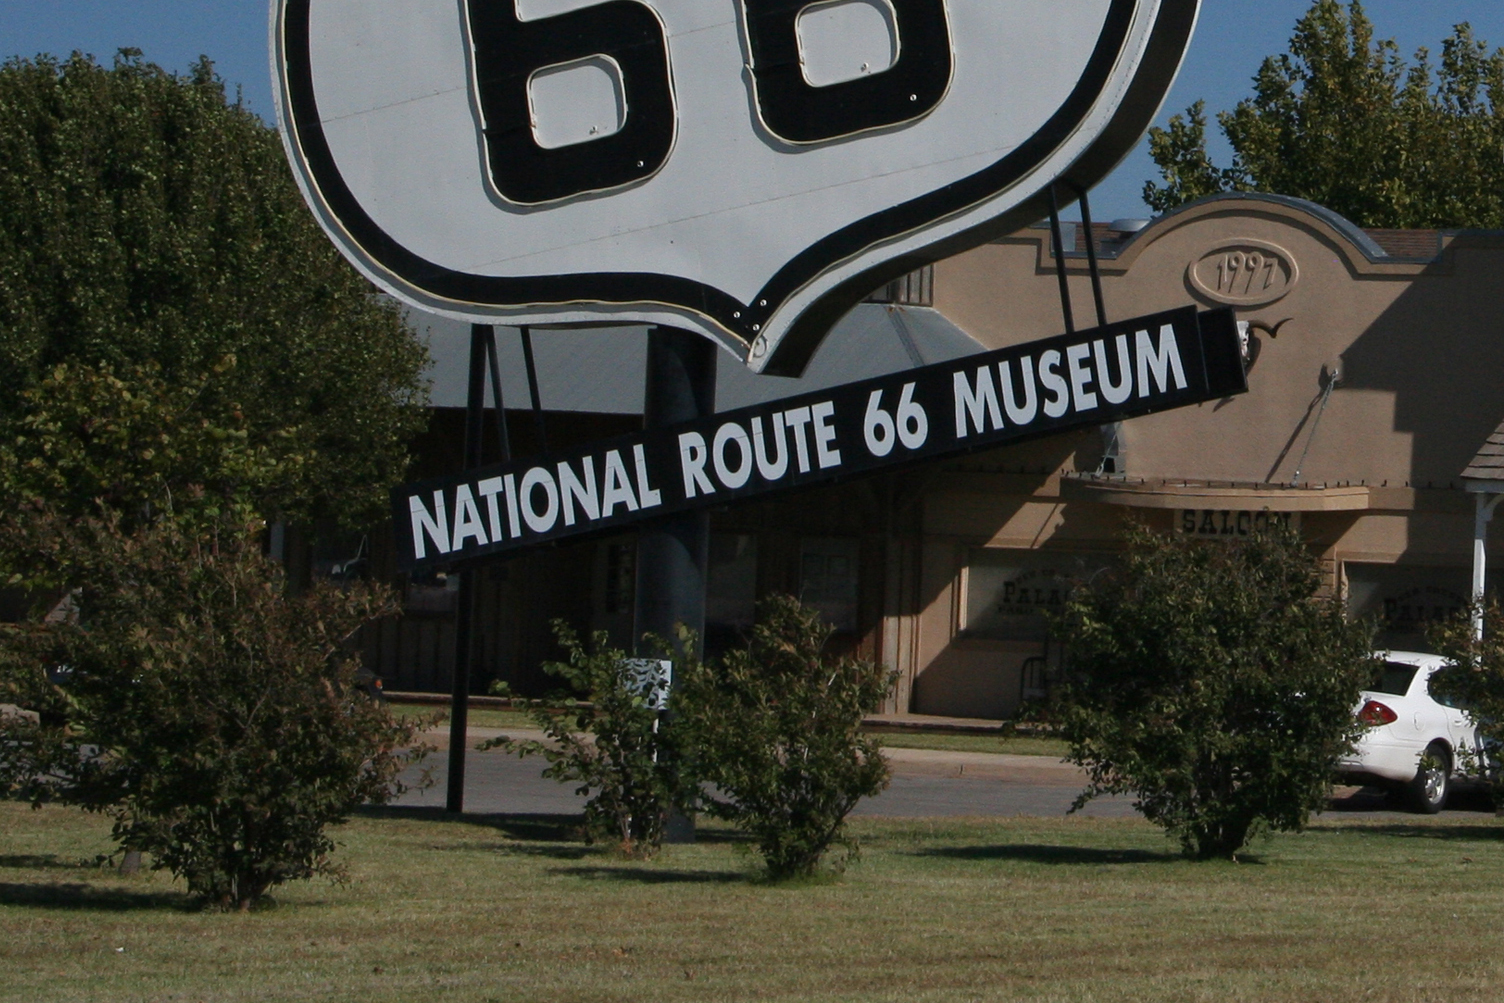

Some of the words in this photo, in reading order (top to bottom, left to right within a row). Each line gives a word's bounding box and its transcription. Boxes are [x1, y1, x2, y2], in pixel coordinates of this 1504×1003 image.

[1216, 250, 1279, 294] 1997
[408, 443, 661, 559] NATIONAL
[679, 401, 841, 497] ROUTE
[863, 381, 928, 457] 66
[953, 323, 1188, 439] MUSEUM
